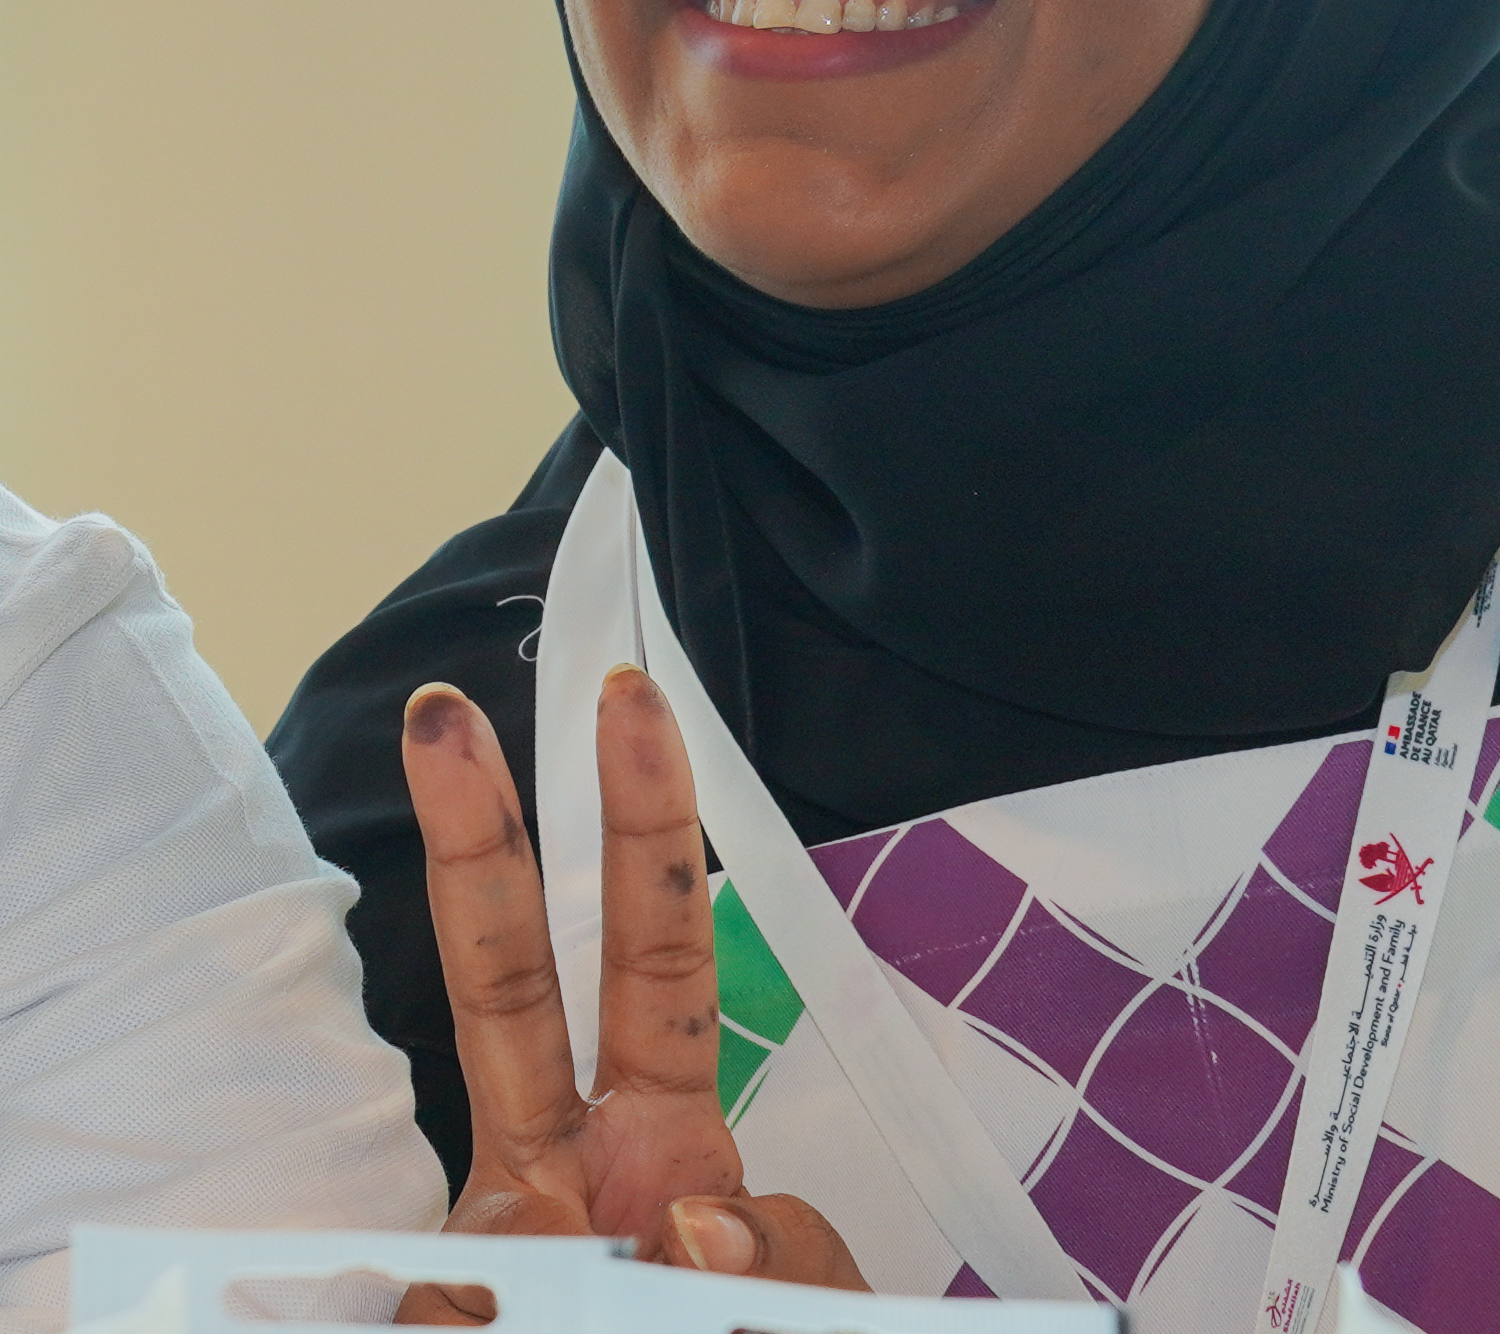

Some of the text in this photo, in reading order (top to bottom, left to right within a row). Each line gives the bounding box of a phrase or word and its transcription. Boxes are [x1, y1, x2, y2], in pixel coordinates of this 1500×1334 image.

[1399, 690, 1422, 759] AMBASSADE
[1410, 699, 1432, 761] DE FRANCE
[1421, 709, 1442, 765] AU QATAR
[1368, 914, 1387, 943] وزارة
[1320, 919, 1406, 1213] Ministry of Social Development and Family
